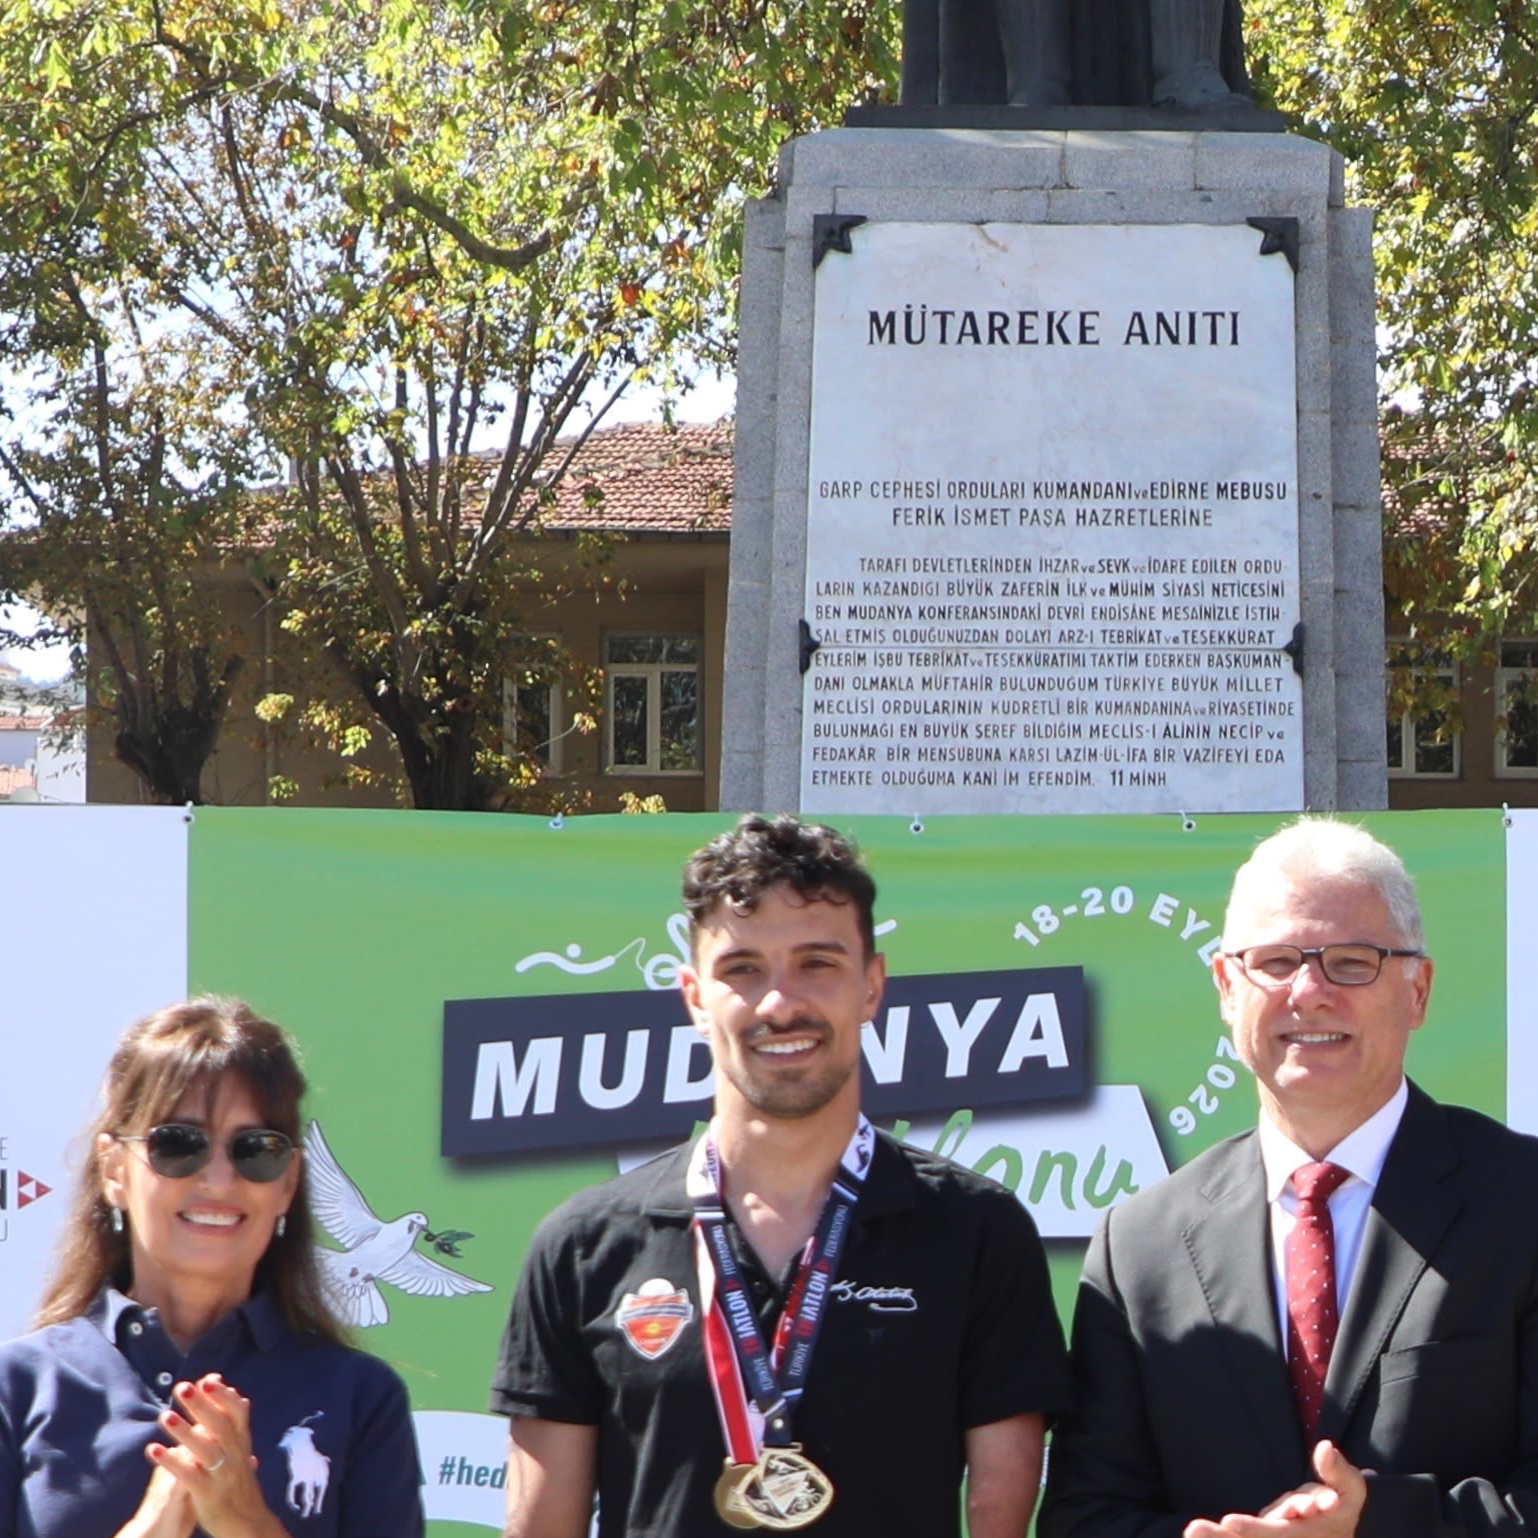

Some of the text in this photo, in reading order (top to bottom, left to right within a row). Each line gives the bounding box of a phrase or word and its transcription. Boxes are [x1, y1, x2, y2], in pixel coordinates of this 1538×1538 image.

[866, 307, 1241, 346] MÜTAREKE ANITI
[819, 481, 863, 498] GARP
[869, 479, 941, 499] CEPHESİ
[946, 481, 1026, 499] ORDULARI
[1032, 481, 1133, 500] KUMANDANI
[1149, 479, 1210, 500] EDİRNE
[1216, 482, 1287, 500] MEBUSU
[892, 505, 1213, 528] FERİK İSMET PAŞA HAZRETLERİNE
[858, 558, 907, 572] TARAFI
[912, 556, 1032, 573] DEVLETLERİNDEN
[1097, 558, 1131, 574] SEVK
[816, 582, 855, 596] LARIN
[946, 578, 994, 596] BÜYÜK
[1000, 580, 1060, 597] ZAFERİN
[1066, 578, 1088, 597] İLK
[1108, 580, 1156, 597] MÜHİM
[1162, 580, 1205, 597] SİYASİ
[1211, 580, 1285, 598] NETİCESİNİ
[815, 605, 842, 619] BEN
[847, 605, 913, 620] MUDANYA
[917, 603, 1042, 620] KONFERANSINDAKİ
[892, 627, 999, 643] OLDUĞUNUZDAN
[815, 648, 867, 667] EYLERİM
[1090, 651, 1139, 667] TAKTİM
[1144, 653, 1201, 668] EDERKEN
[814, 677, 845, 692] DANI
[851, 676, 915, 691] OLMAKLA
[1104, 676, 1165, 691] TÜRKİYE
[1226, 675, 1283, 692] MİLLET
[813, 697, 875, 714] MECLİSİ
[881, 700, 983, 715] ORDULARININ
[990, 698, 1061, 715] KUDRETLİ
[1066, 698, 1089, 715] BİR
[899, 724, 918, 738] EN
[886, 744, 911, 761] BİR
[1254, 749, 1285, 763] EDA
[811, 770, 873, 785] ETMEKTE
[881, 768, 956, 786] OLDUĞUMA
[1012, 885, 1135, 948] 18-20
[470, 992, 1069, 1121] MUDNYA
